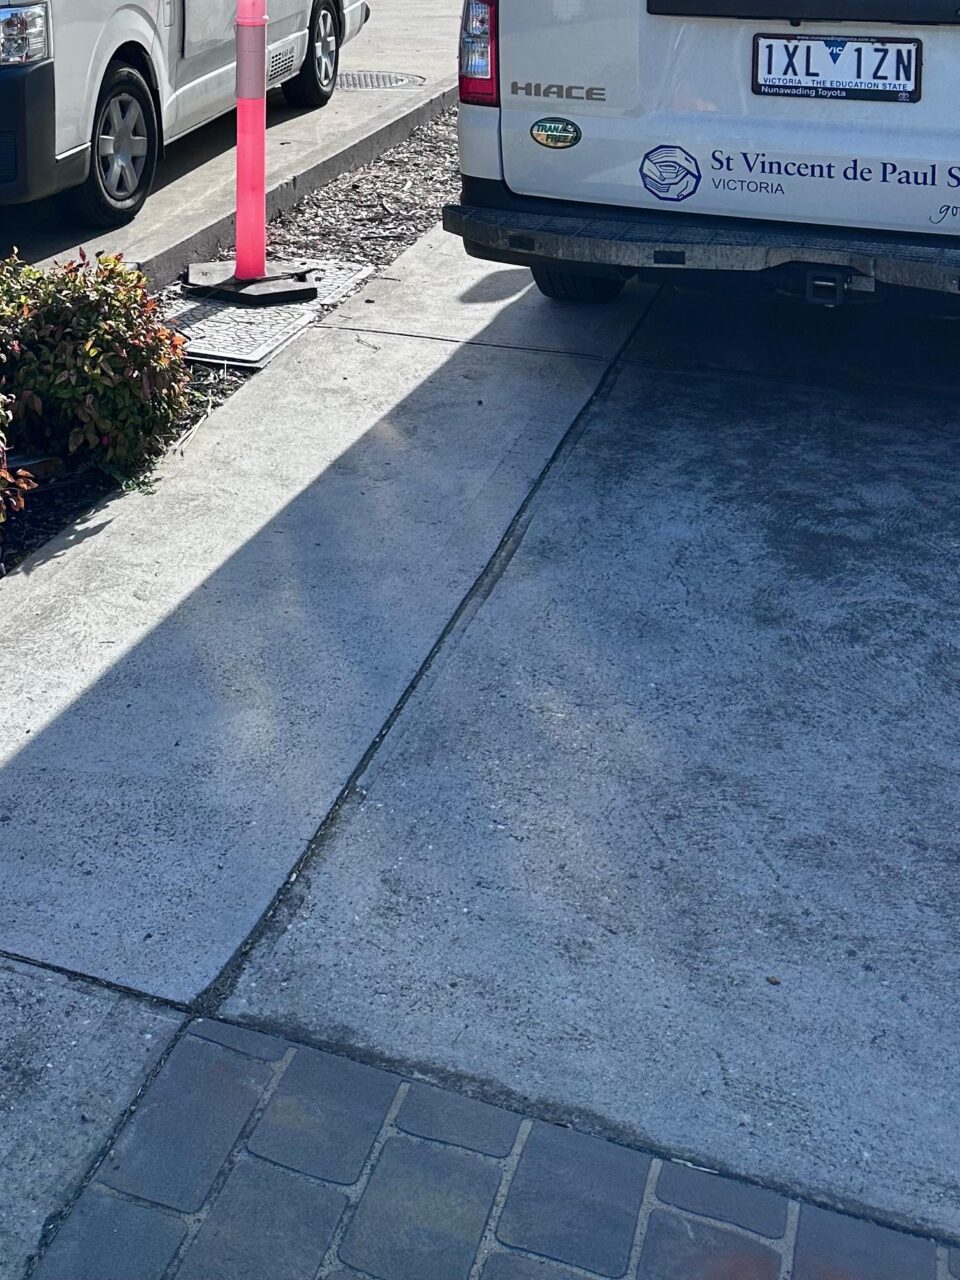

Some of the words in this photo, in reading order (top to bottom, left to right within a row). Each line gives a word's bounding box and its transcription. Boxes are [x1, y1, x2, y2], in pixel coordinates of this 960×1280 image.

[765, 43, 820, 77] 1XL
[854, 47, 912, 81] 1ZN
[511, 81, 606, 102] HIACE
[761, 86, 816, 97] Nunawading
[818, 88, 846, 97] Toyota
[763, 77, 802, 86] VICTORIA
[811, 79, 827, 87] THE
[830, 80, 881, 89] EDUCATION
[882, 82, 908, 91] STATE
[711, 150, 733, 171] St
[741, 152, 835, 179] Vincent
[843, 159, 872, 182] de
[880, 162, 938, 186] Paul
[712, 178, 785, 194] VICTORIA
